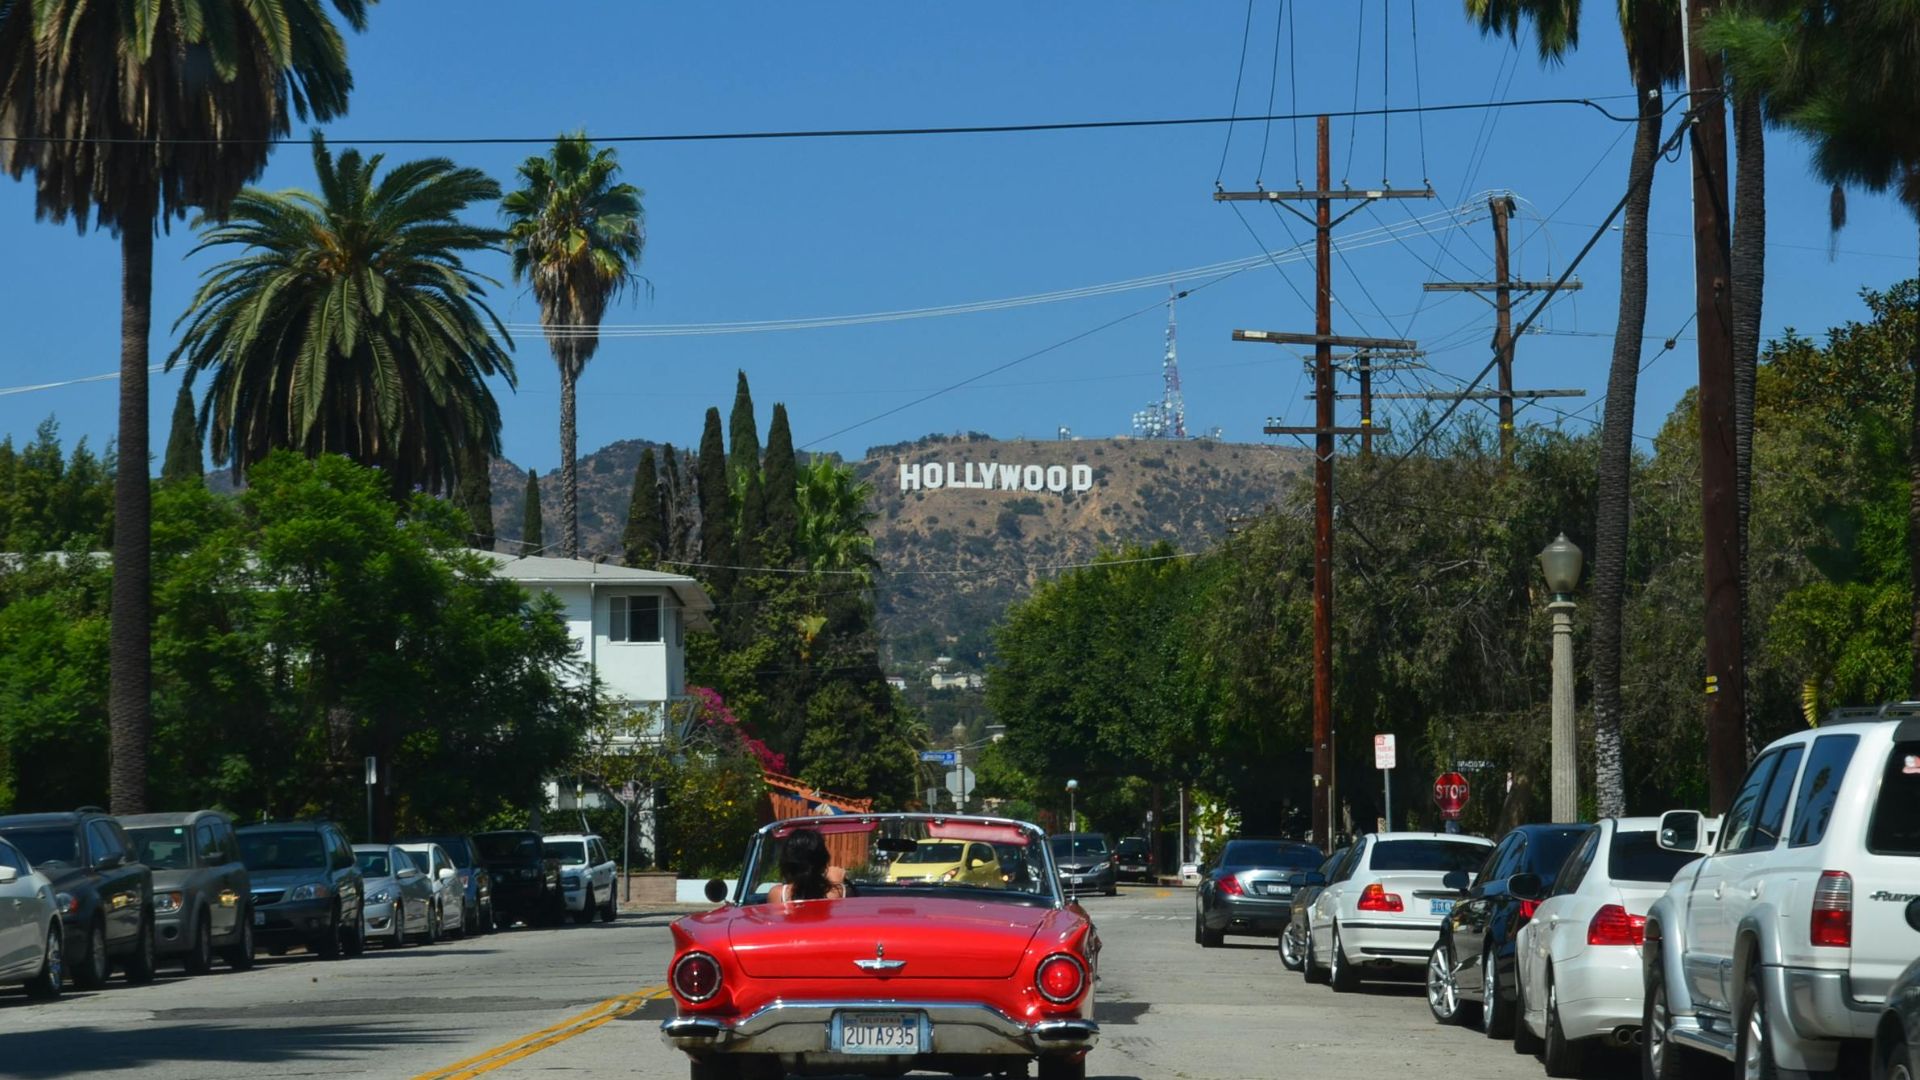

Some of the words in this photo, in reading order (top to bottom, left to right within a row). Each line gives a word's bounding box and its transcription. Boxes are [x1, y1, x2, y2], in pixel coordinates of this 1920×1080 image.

[900, 462, 1092, 491] HOLLYWOOD
[1436, 784, 1467, 799] STOP
[846, 1026, 914, 1046] 2UTA935
